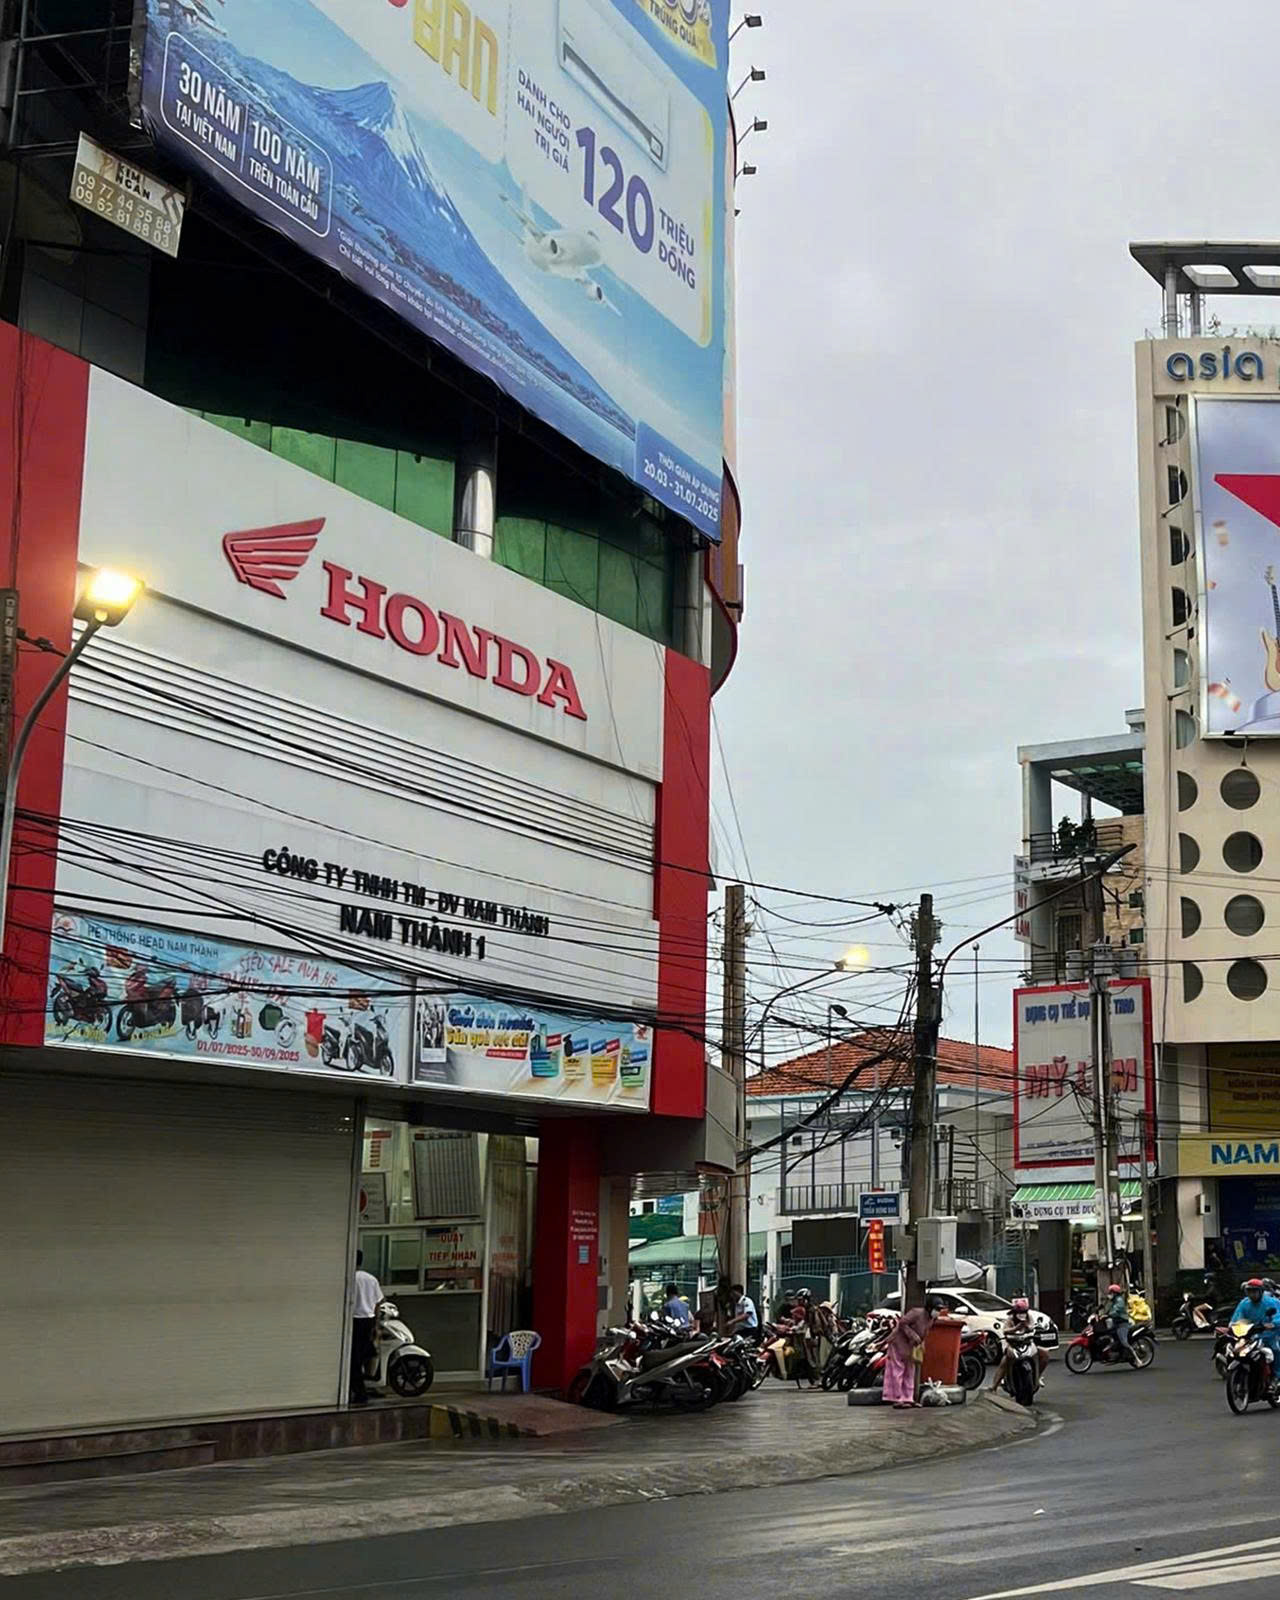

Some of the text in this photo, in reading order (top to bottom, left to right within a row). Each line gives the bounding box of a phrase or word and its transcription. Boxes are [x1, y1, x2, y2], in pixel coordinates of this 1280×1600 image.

[179, 61, 241, 135] 30 NĂM
[516, 90, 571, 152] HAI NGƯỜI
[518, 69, 571, 130] DÀNH CHO
[176, 99, 237, 163] TẠI VIỆT NAM
[252, 120, 320, 195] 100 NĂM
[534, 128, 570, 173] TRỊ GIÁ
[75, 186, 169, 248] 09 62 81 88 03
[78, 171, 172, 234] 09 77 44 55 88
[249, 157, 319, 221] TRÊN TOÀN CẦU
[576, 126, 655, 254] 120
[659, 207, 695, 257] TRIỆU
[658, 241, 696, 289] ĐỒNG
[1166, 345, 1264, 382] asia
[643, 458, 668, 488] 20.03
[673, 481, 719, 522] 31.07.2025
[674, 465, 692, 483] GIAN
[320, 560, 588, 721] HONDA
[262, 847, 318, 882] CÔNG
[323, 862, 348, 888] TY
[352, 870, 398, 902] TNHH
[463, 898, 498, 925] NAM
[501, 906, 550, 936] THÀNH
[340, 905, 487, 960] NAM THÀNH 1
[268, 956, 296, 974] SALE
[1078, 1001, 1091, 1020] DỤ
[1075, 1058, 1138, 1096] LM
[1211, 1142, 1280, 1165] NAM
